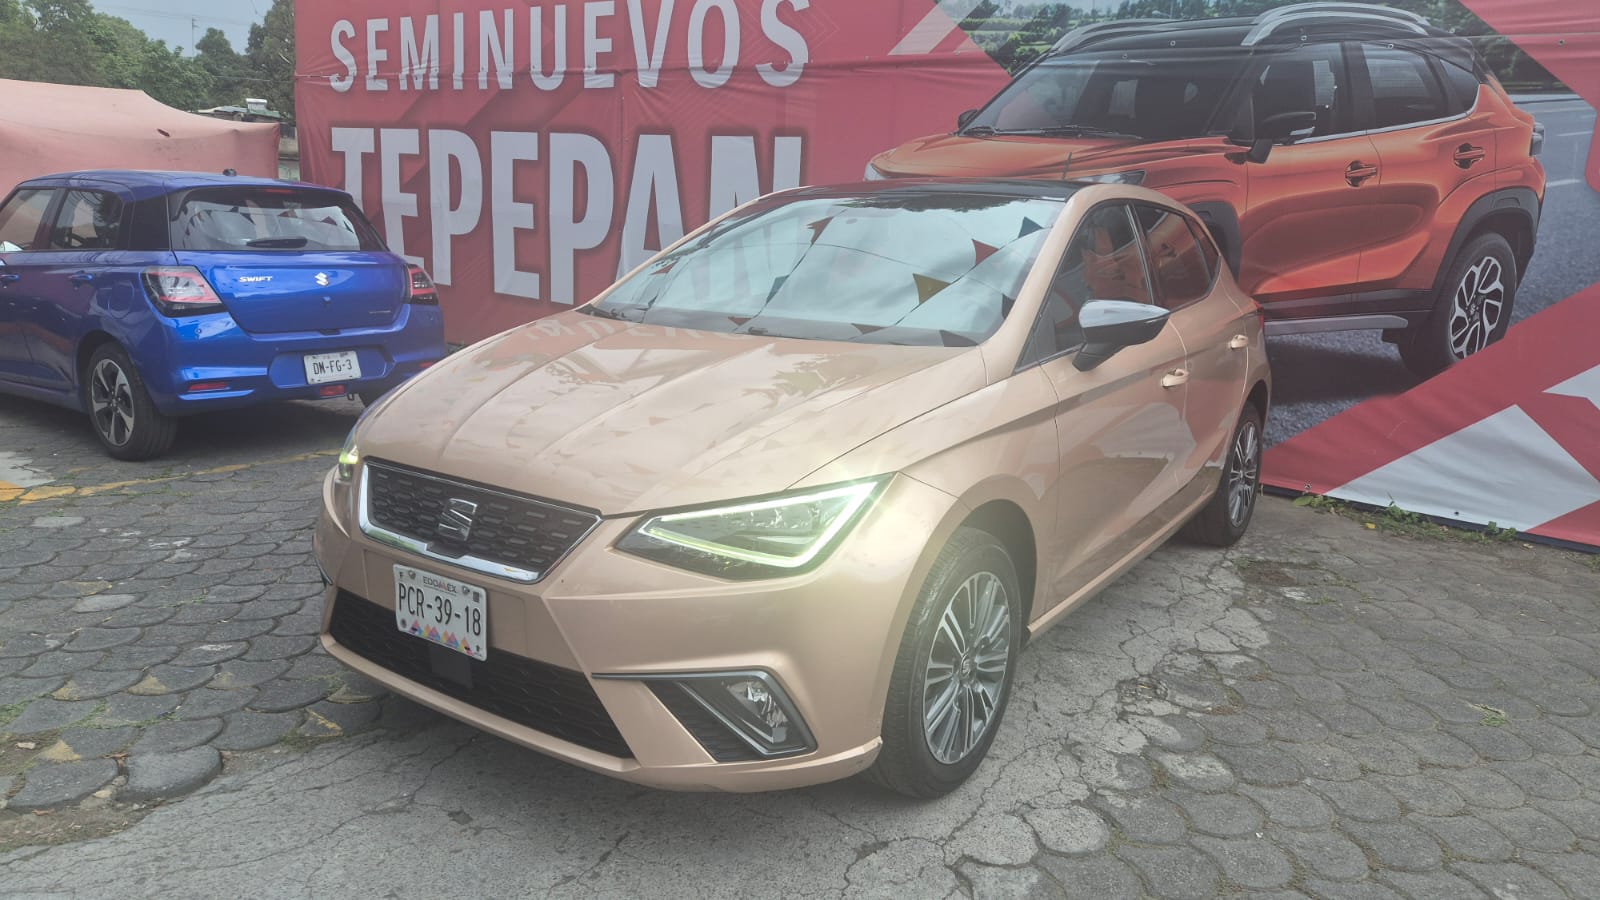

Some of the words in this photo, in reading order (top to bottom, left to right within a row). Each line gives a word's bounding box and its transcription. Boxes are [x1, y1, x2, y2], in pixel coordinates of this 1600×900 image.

[329, 0, 809, 93] SEMINUEVOS
[312, 359, 353, 375] DM-FG-3
[398, 583, 481, 636] PCR-39-18
